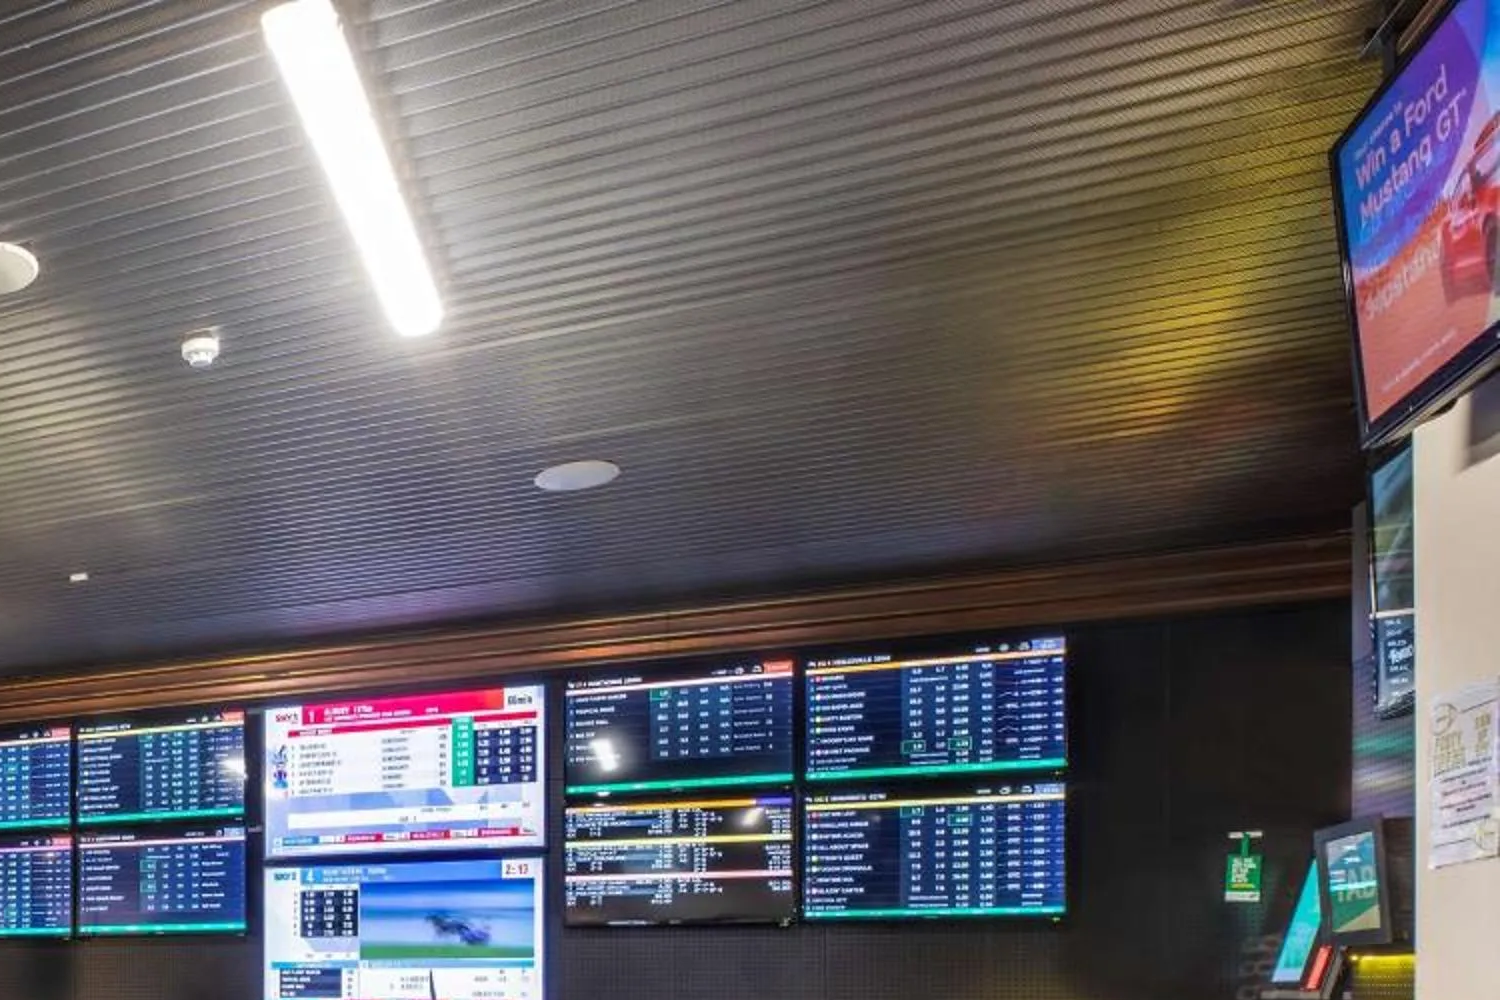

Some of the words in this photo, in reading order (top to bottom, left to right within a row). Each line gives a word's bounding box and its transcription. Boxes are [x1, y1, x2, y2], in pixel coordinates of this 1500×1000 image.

[1389, 128, 1402, 155] a
[1404, 64, 1448, 137] Ford
[1359, 134, 1433, 223] Mustang
